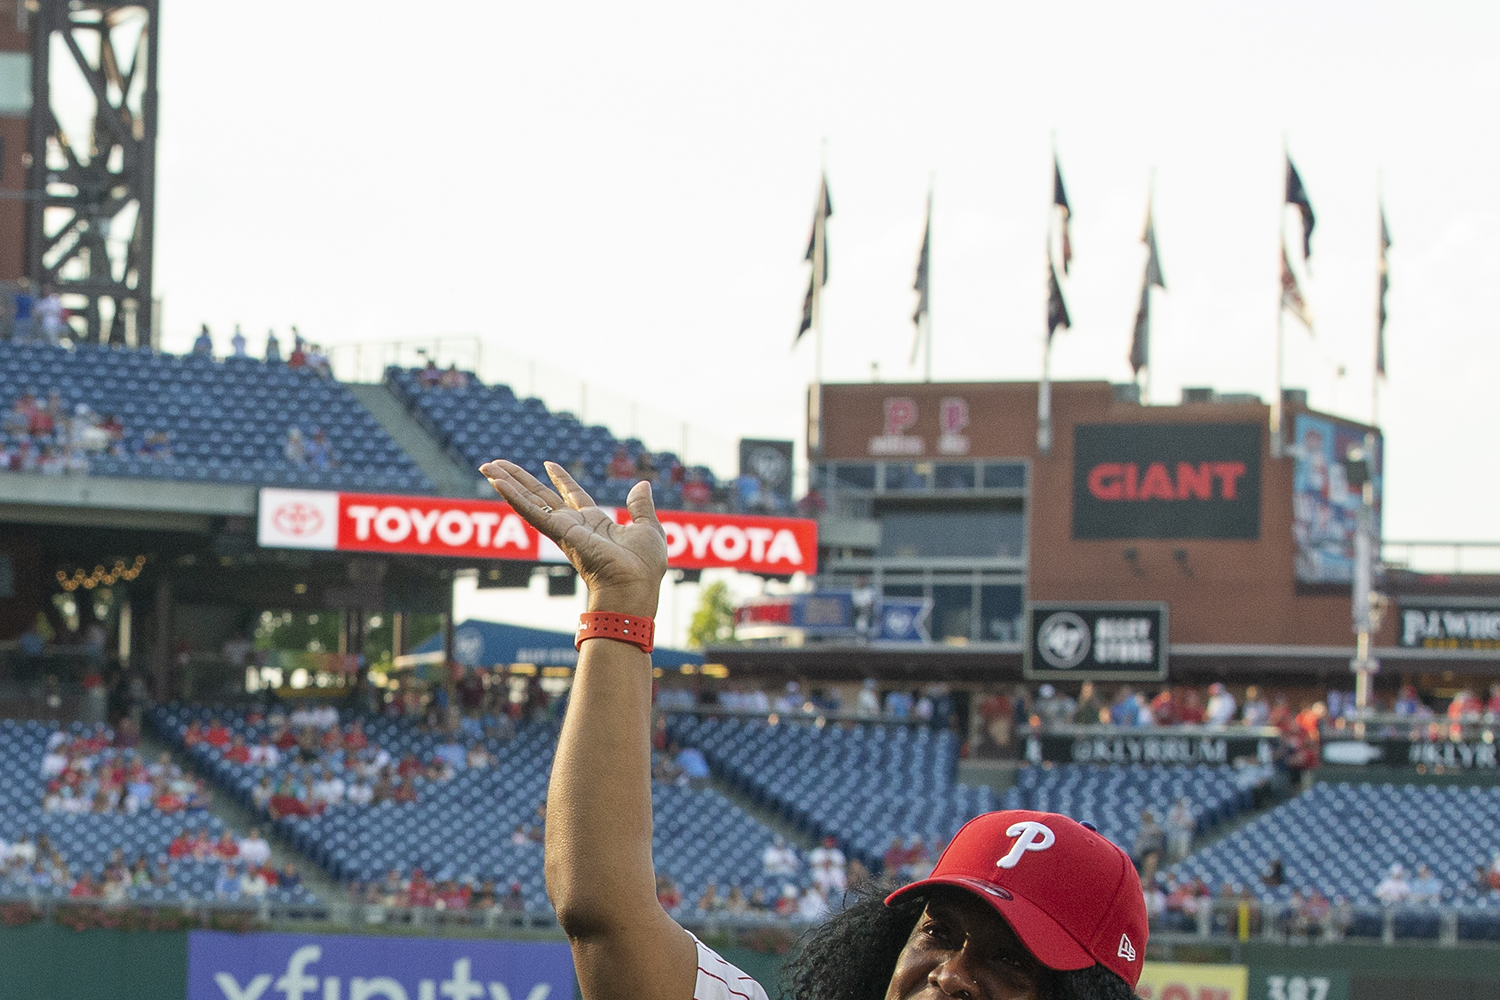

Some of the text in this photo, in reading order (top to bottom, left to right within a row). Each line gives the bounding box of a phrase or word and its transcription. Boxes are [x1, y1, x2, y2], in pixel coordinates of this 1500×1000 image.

[1088, 462, 1246, 501] GIANT
[346, 505, 530, 550] TOYOTA
[996, 821, 1056, 869] P
